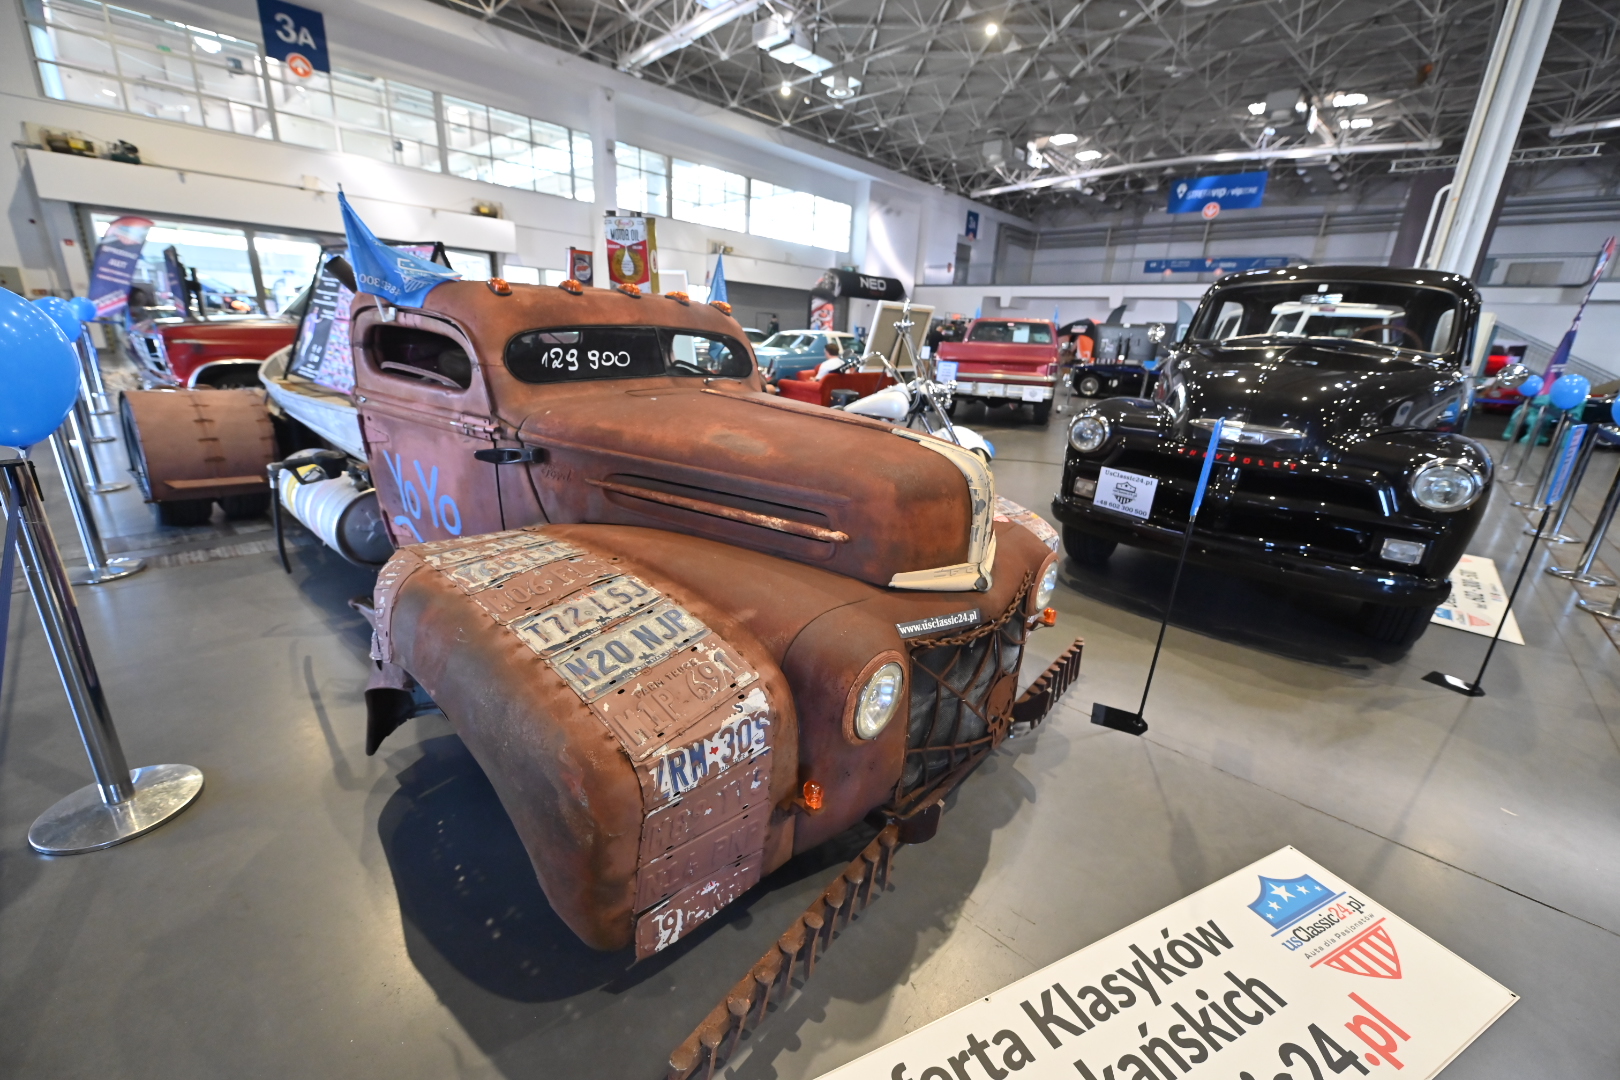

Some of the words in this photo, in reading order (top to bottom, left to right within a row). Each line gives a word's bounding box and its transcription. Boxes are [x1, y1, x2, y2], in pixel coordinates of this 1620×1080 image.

[274, 12, 318, 50] 3A
[610, 228, 630, 241] MOTOR
[631, 228, 640, 242] OIL
[541, 347, 579, 371] 129
[587, 350, 631, 370] 900
[1108, 502, 1120, 510] 602
[1134, 508, 1148, 517] 500
[522, 605, 594, 645] T72
[589, 580, 650, 614] LSJ
[899, 610, 977, 635] www.usclassic24.pl
[565, 640, 635, 687] N20
[630, 609, 688, 652] NJP
[664, 657, 699, 681] TRUCK
[614, 688, 679, 747] M1P
[686, 649, 751, 701] 691
[1281, 896, 1365, 951] usClassic24.pl
[1304, 945, 1325, 960] Auta
[1323, 937, 1337, 948] dla
[1335, 913, 1375, 940] Pasjonatów
[1019, 919, 1235, 1050] Klasyków
